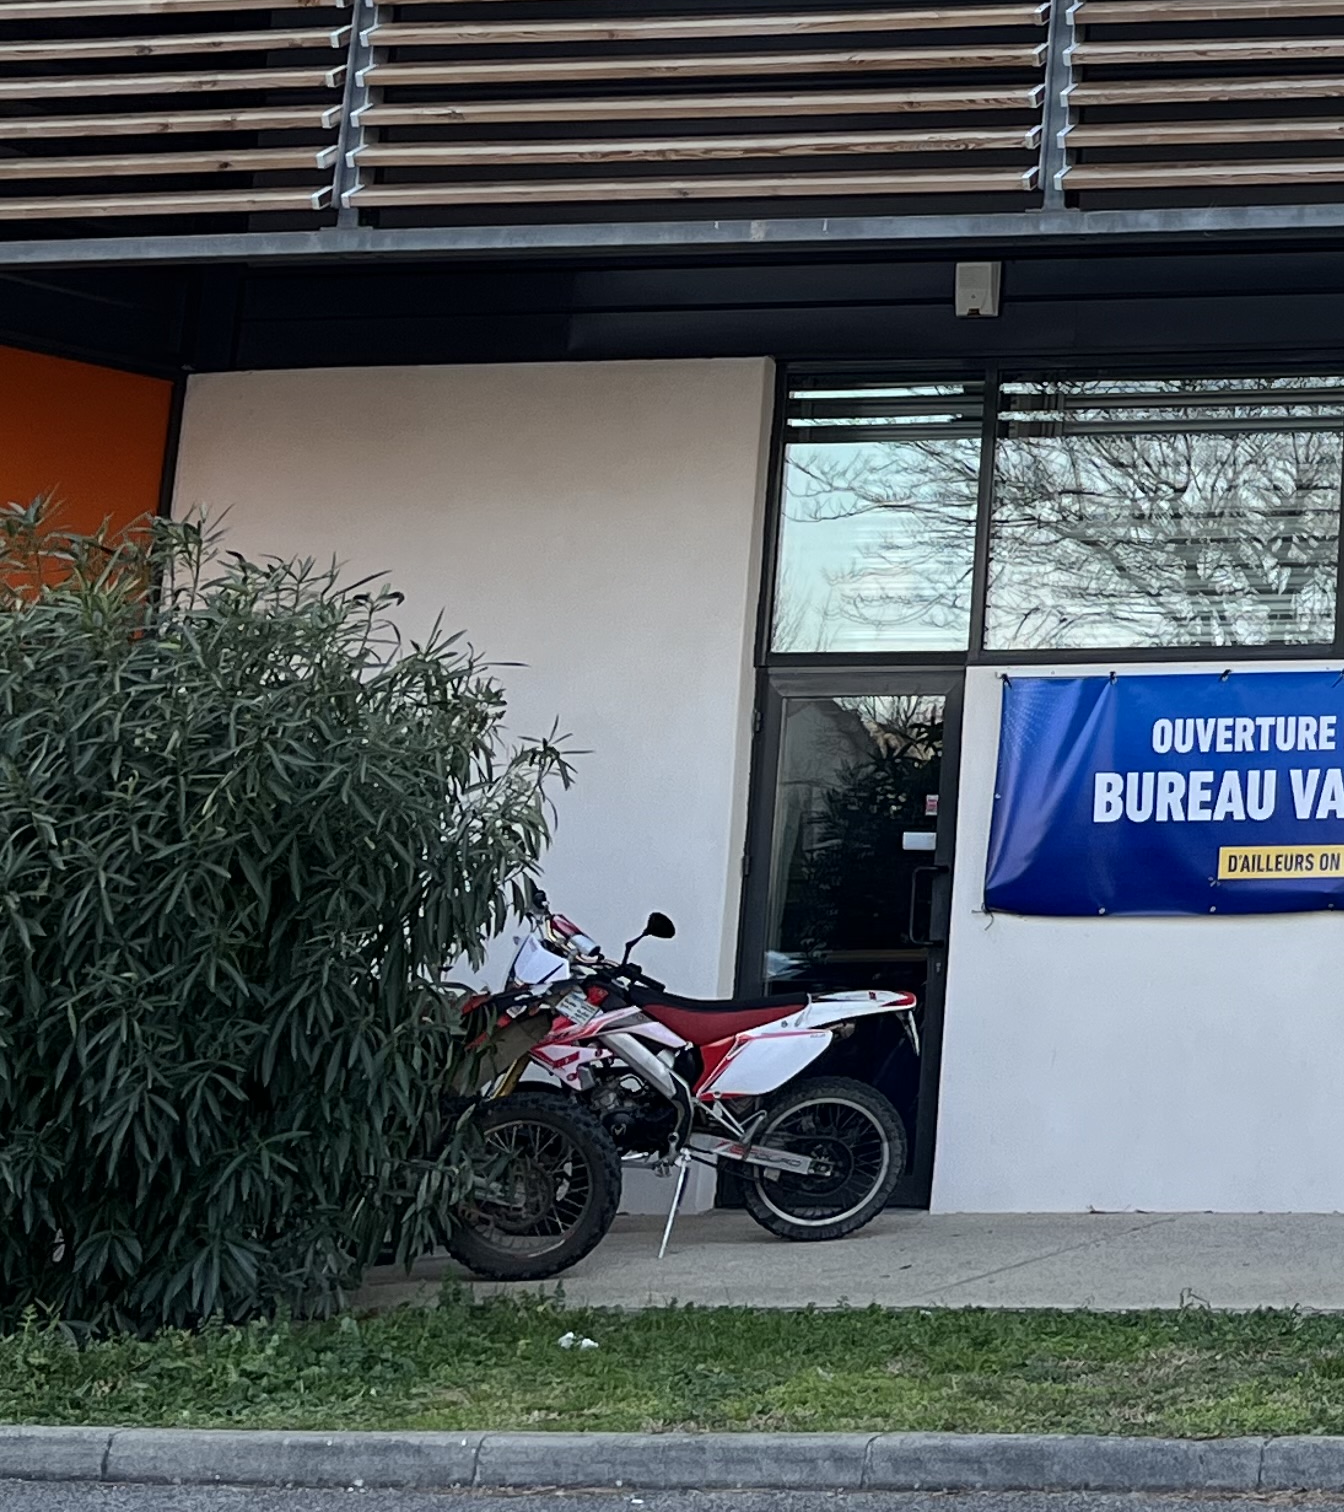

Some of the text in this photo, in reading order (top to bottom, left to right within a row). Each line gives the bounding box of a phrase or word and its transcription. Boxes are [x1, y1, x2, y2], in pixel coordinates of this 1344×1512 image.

[1152, 716, 1337, 754] OUVERTURE
[1093, 769, 1277, 823] BUREAU
[1227, 854, 1315, 873] D'AILLEURS
[1319, 853, 1341, 871] ON
